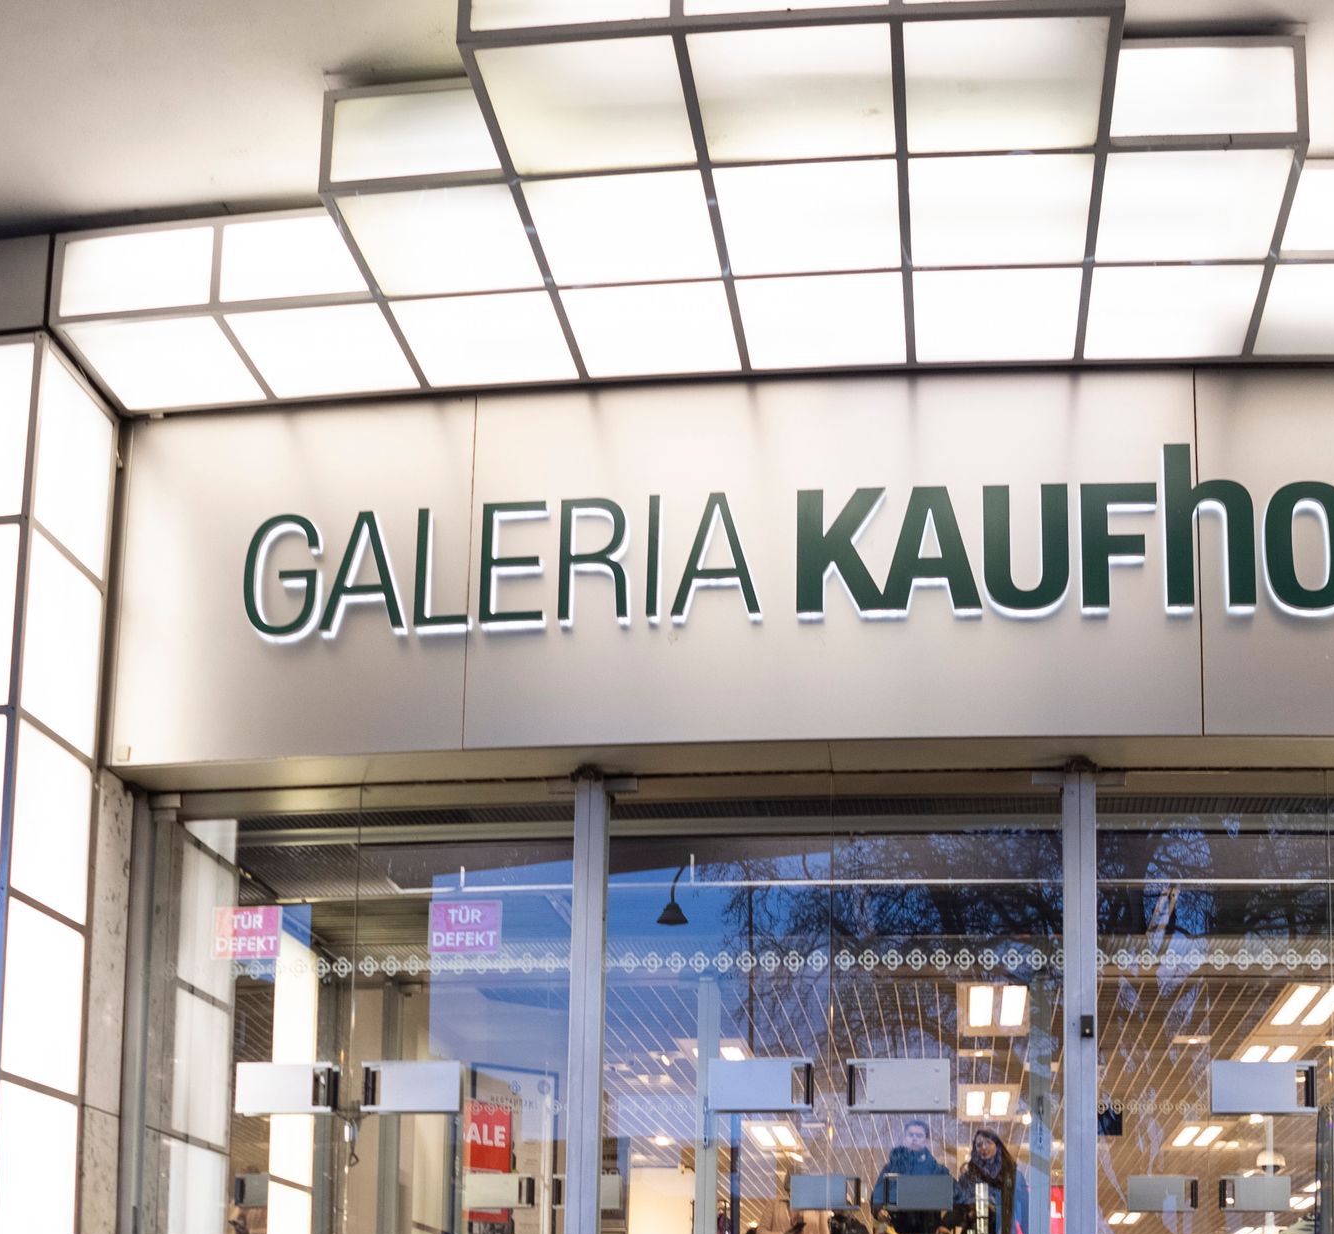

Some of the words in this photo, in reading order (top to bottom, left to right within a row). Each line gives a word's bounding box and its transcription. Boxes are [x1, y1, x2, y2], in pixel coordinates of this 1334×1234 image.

[243, 488, 763, 643] GALERIA
[231, 910, 263, 931] TÜR
[448, 905, 482, 926] TÜR
[216, 932, 277, 955] DEFEKT
[433, 927, 498, 949] DEFEKT
[464, 1123, 506, 1148] ALE
